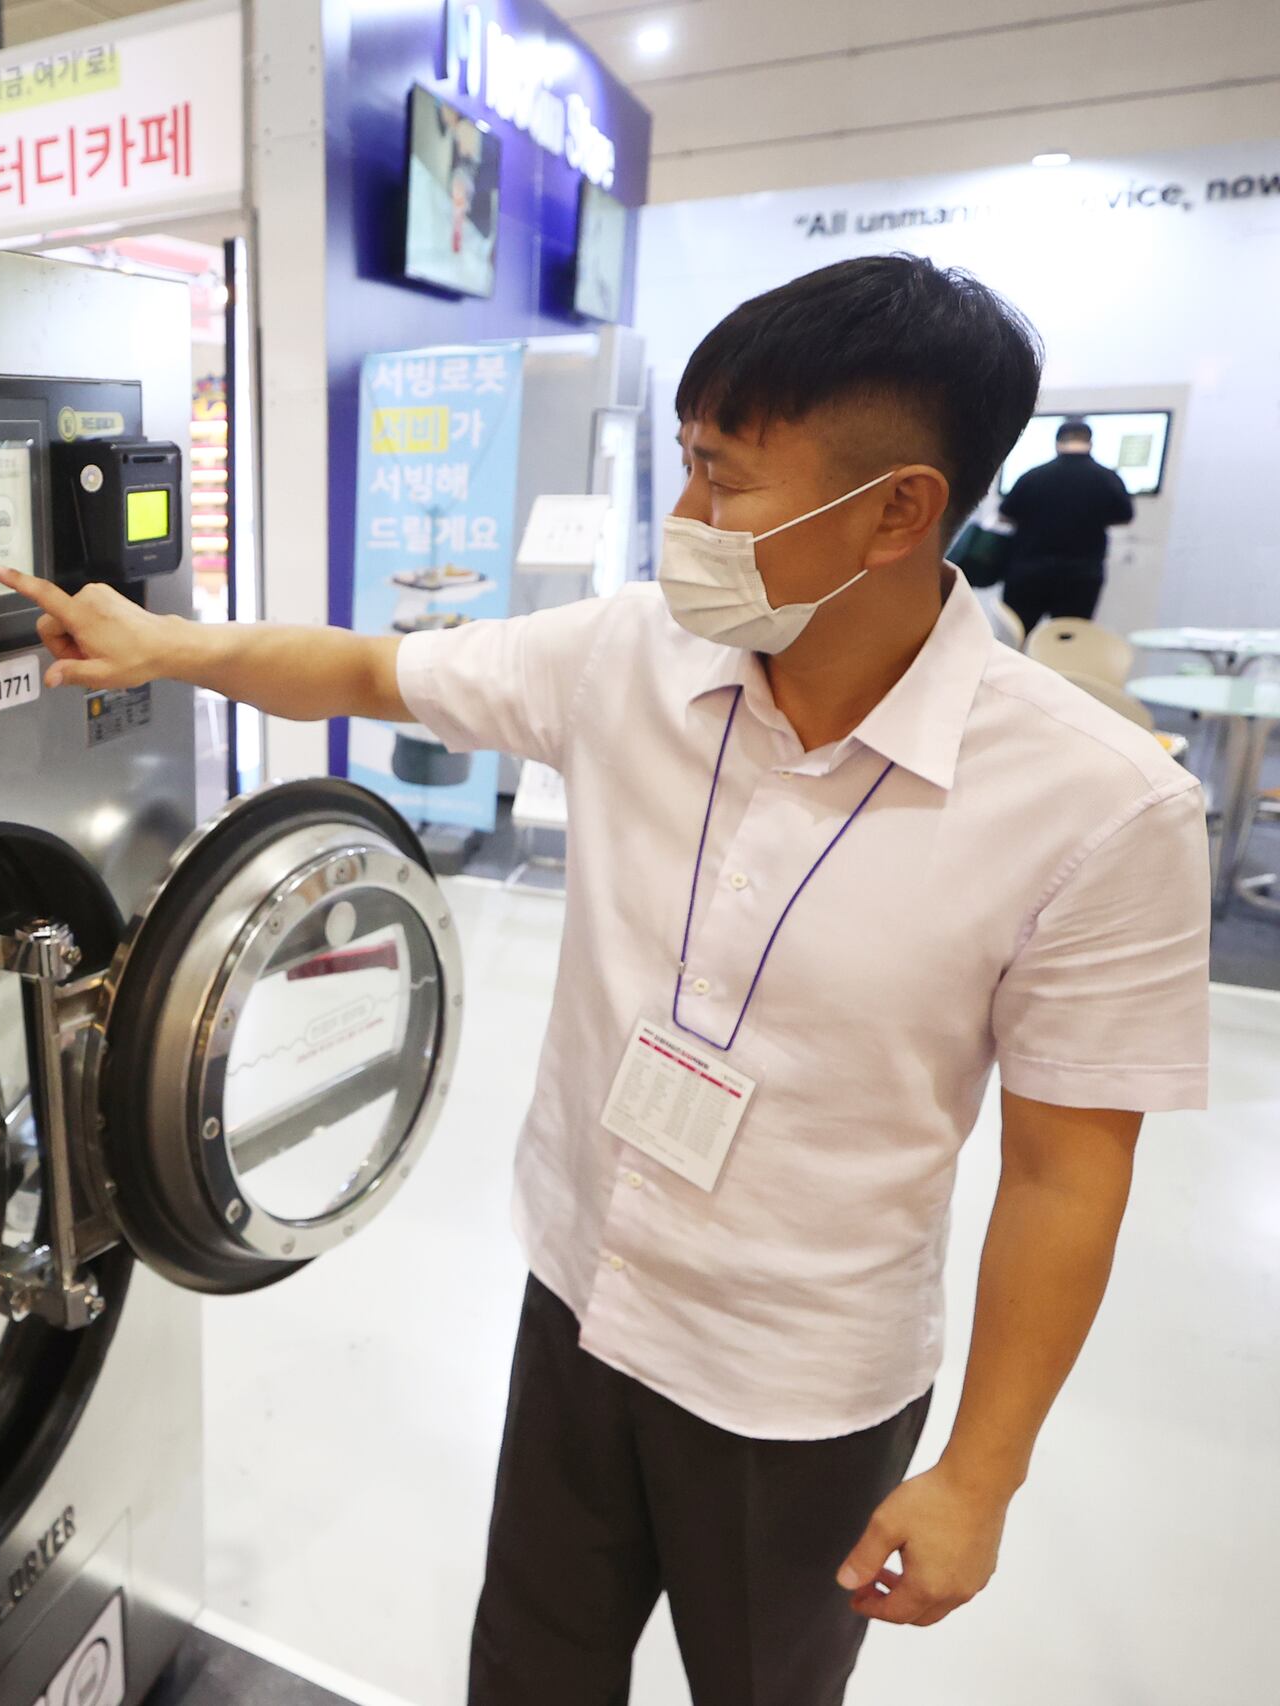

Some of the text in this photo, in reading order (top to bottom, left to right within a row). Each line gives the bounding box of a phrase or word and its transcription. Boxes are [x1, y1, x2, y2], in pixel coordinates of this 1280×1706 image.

[372, 355, 506, 395] 서빙로봇
[370, 464, 468, 502] 서빙해
[367, 516, 499, 552] 드릴게요
